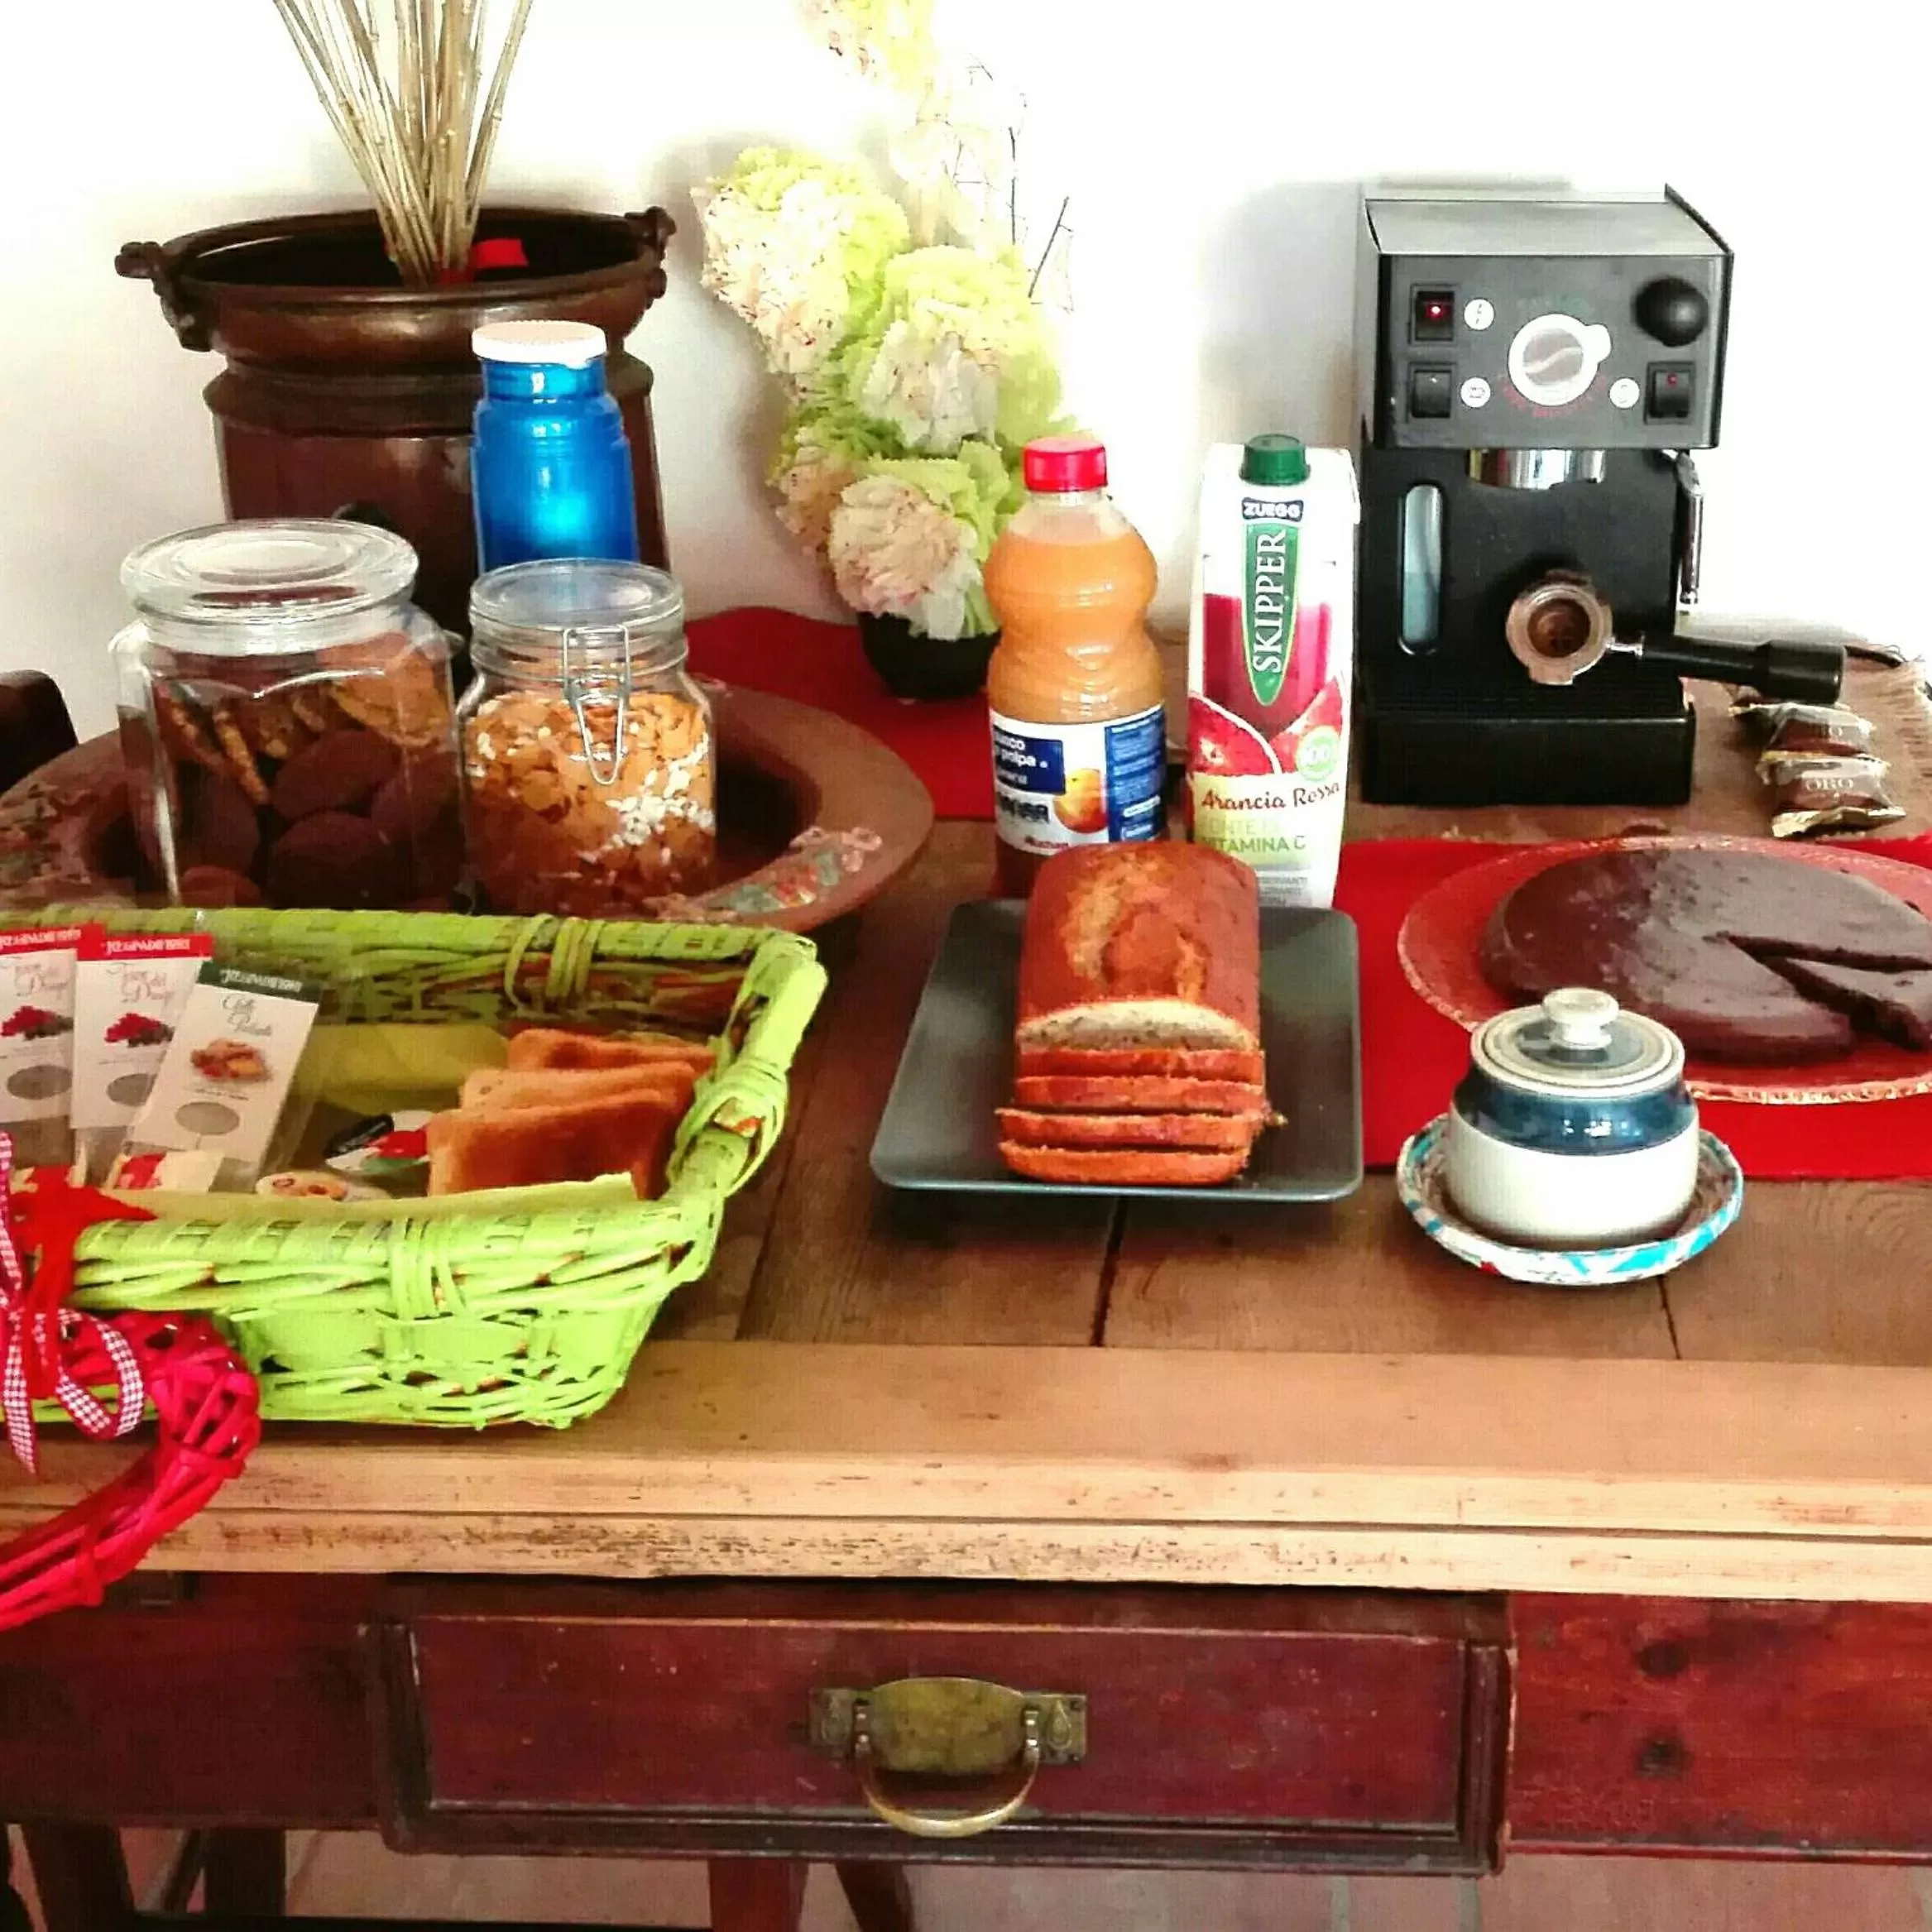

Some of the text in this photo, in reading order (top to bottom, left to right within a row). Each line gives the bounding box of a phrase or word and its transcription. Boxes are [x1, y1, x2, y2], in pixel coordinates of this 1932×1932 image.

[1243, 501, 1302, 518] ZUEGG
[1253, 529, 1287, 674] SKIPPER
[1805, 778, 1854, 792] ORO
[1202, 782, 1340, 811] Arancia Rossa
[1294, 835, 1306, 850] C
